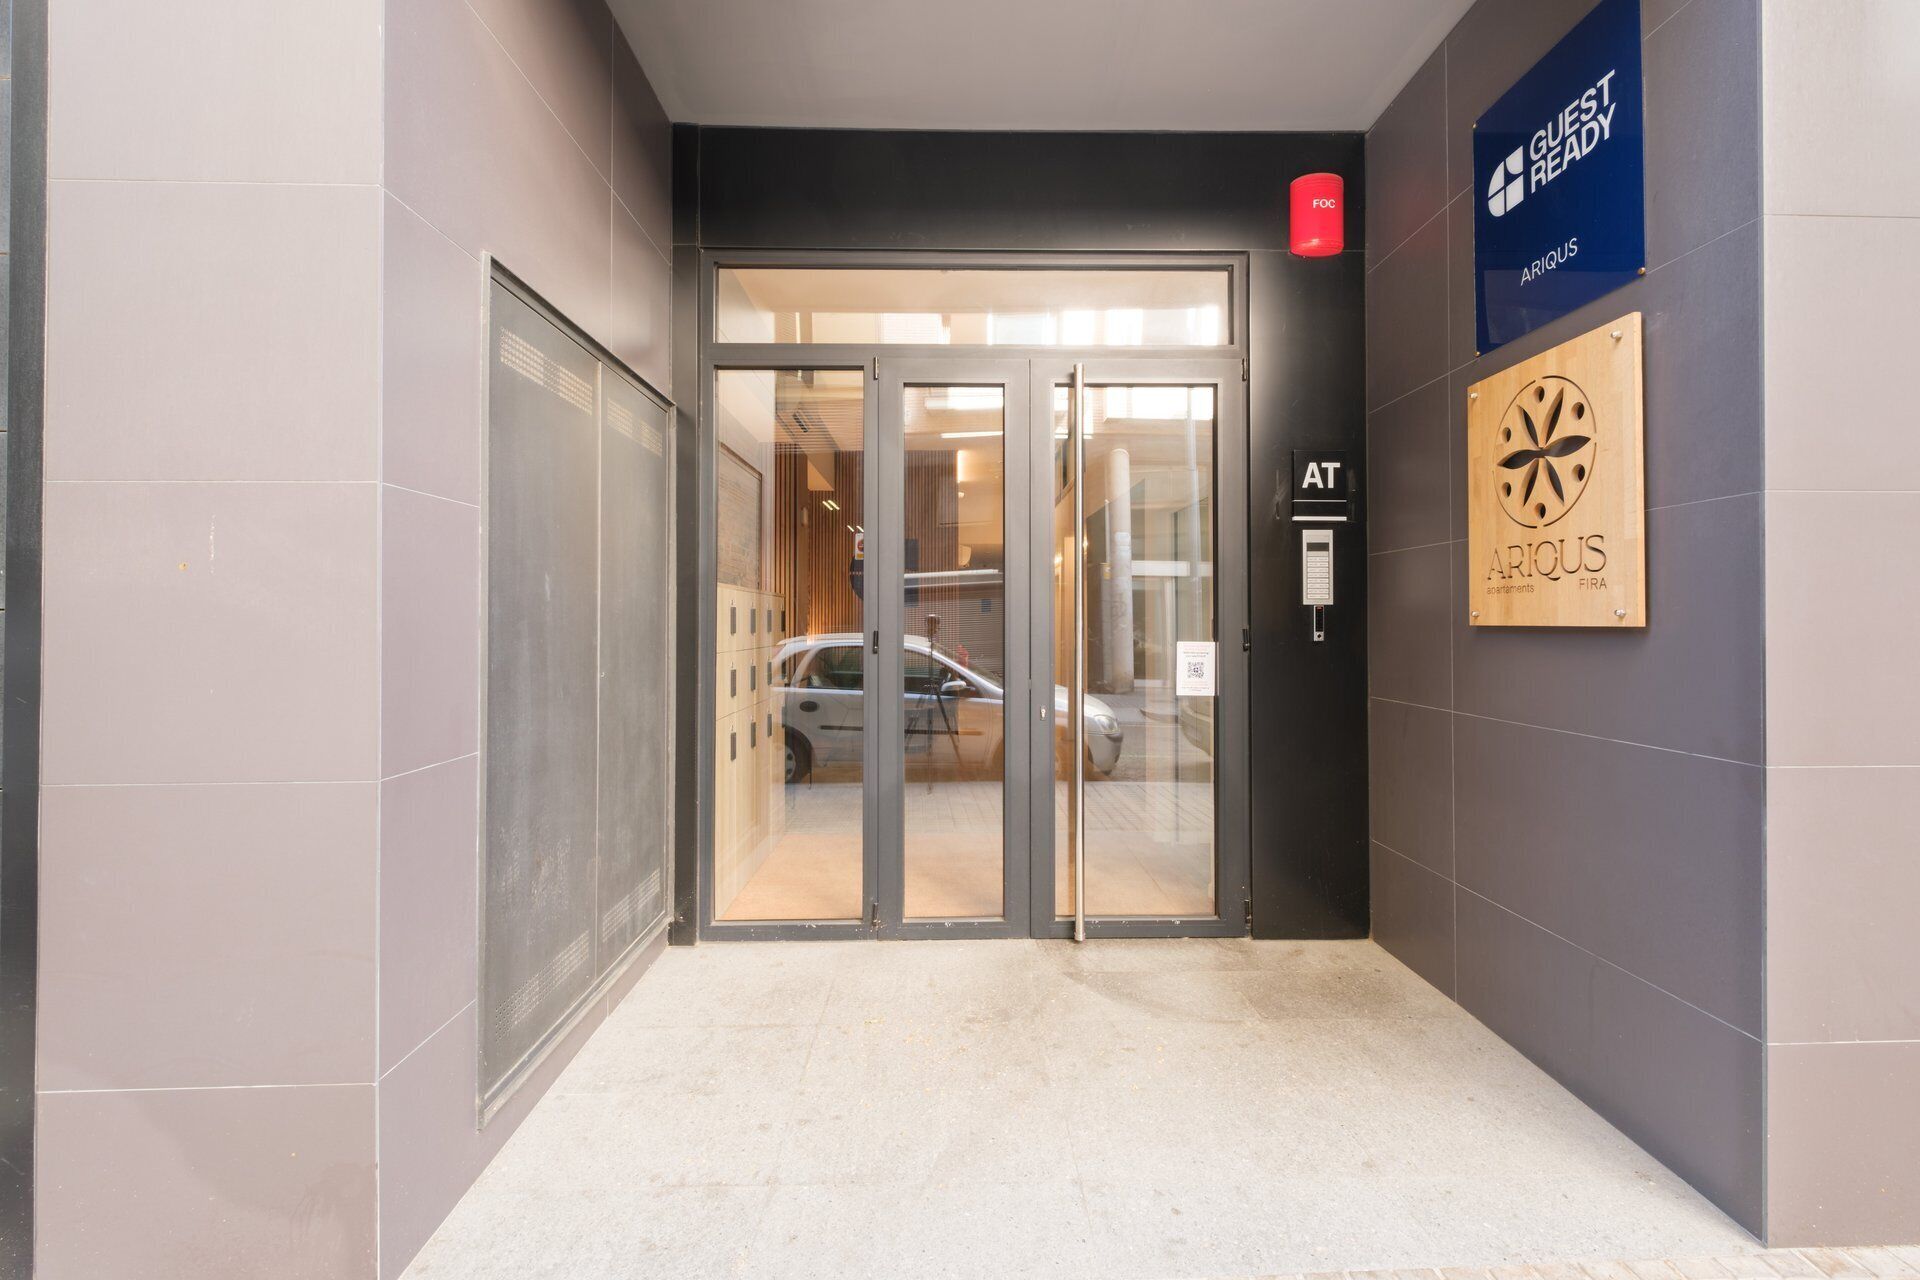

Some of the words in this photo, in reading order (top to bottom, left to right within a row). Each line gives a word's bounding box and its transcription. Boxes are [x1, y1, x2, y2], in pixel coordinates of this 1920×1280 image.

[1529, 69, 1616, 162] GUEST
[1531, 102, 1616, 194] READY
[1312, 198, 1336, 209] FOC
[1520, 237, 1578, 286] ARIQUS
[1301, 462, 1341, 489] AT
[1487, 534, 1607, 581] ARIQUS
[1486, 583, 1535, 595] apartaments
[1579, 577, 1608, 591] FIRA
